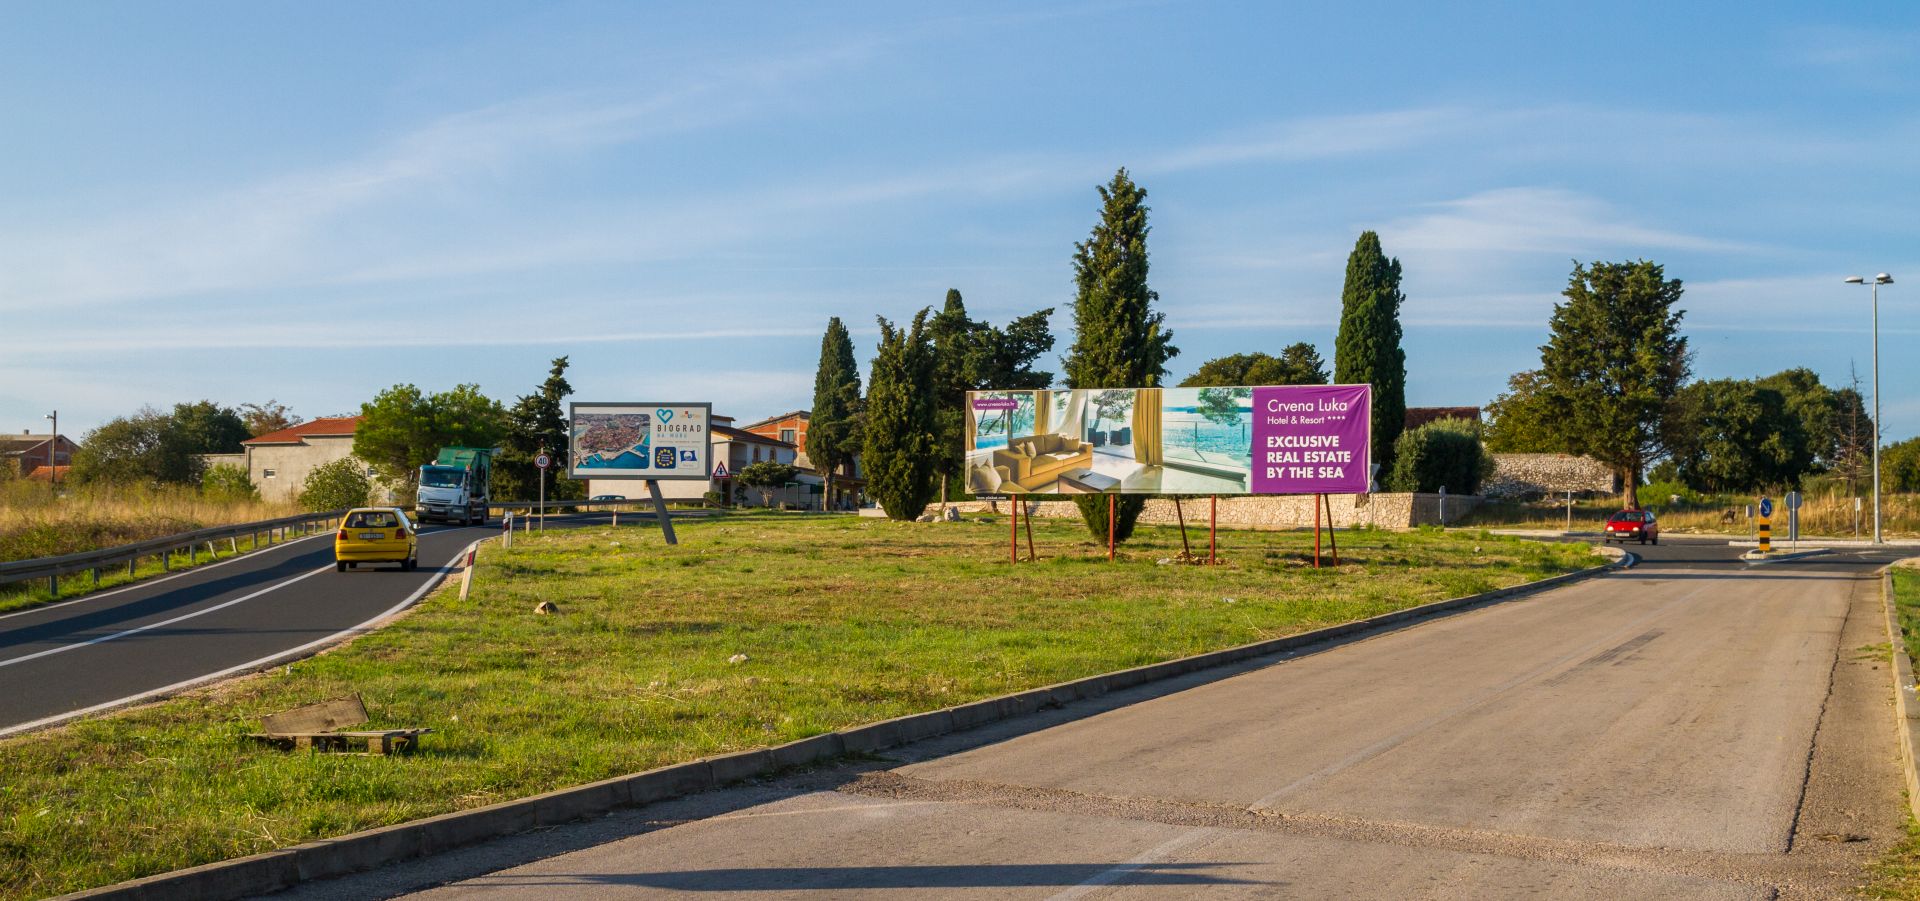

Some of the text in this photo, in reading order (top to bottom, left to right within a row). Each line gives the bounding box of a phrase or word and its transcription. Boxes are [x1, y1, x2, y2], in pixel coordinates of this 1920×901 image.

[1267, 397, 1348, 412] Crvena Luka
[1267, 416, 1325, 424] Hotel & Resort
[657, 424, 702, 432] BIOGRAD
[1267, 435, 1339, 448] EXCLUSIVE
[1267, 451, 1351, 463] REAL ESTATE
[1267, 467, 1344, 478] BY THE SEA
